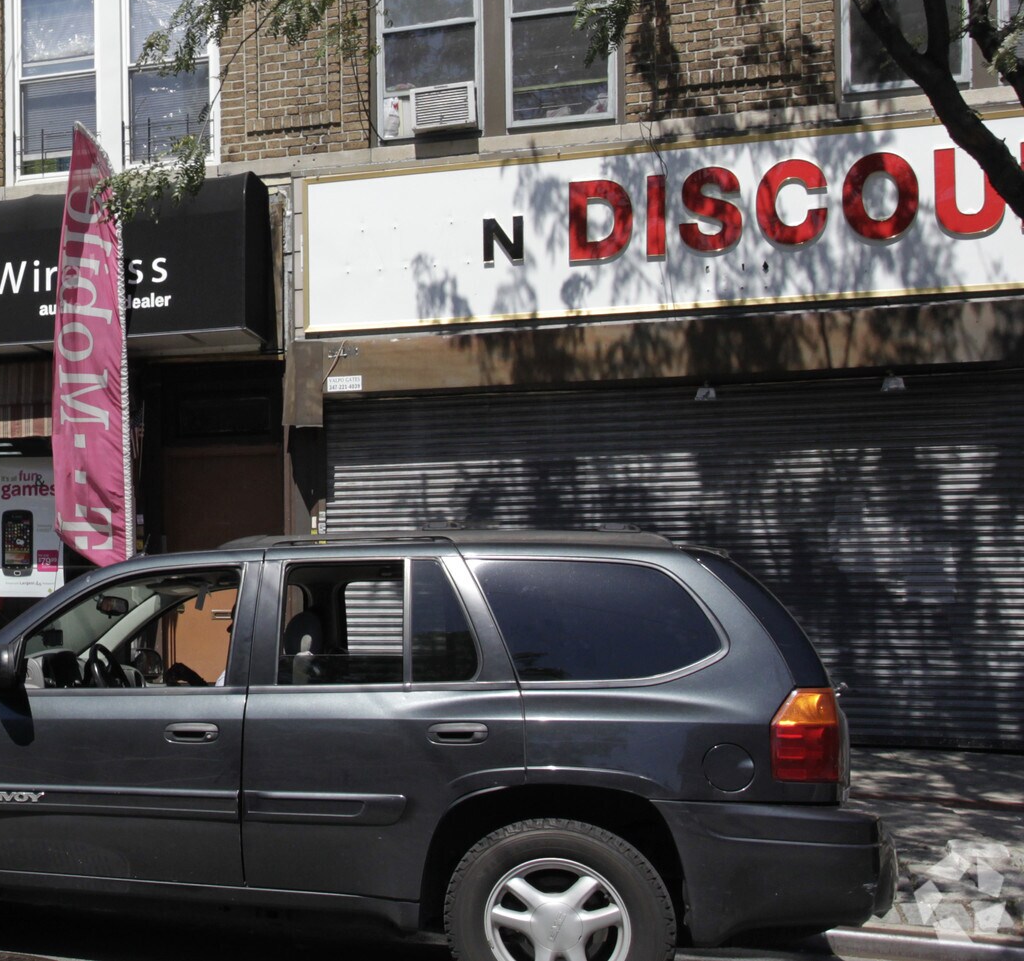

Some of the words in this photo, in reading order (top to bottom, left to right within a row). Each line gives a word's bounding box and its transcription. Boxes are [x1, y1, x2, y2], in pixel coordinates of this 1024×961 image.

[568, 144, 1024, 264] DISCOU
[483, 215, 524, 267] N
[1, 483, 55, 500] games
[19, 470, 38, 482] fun
